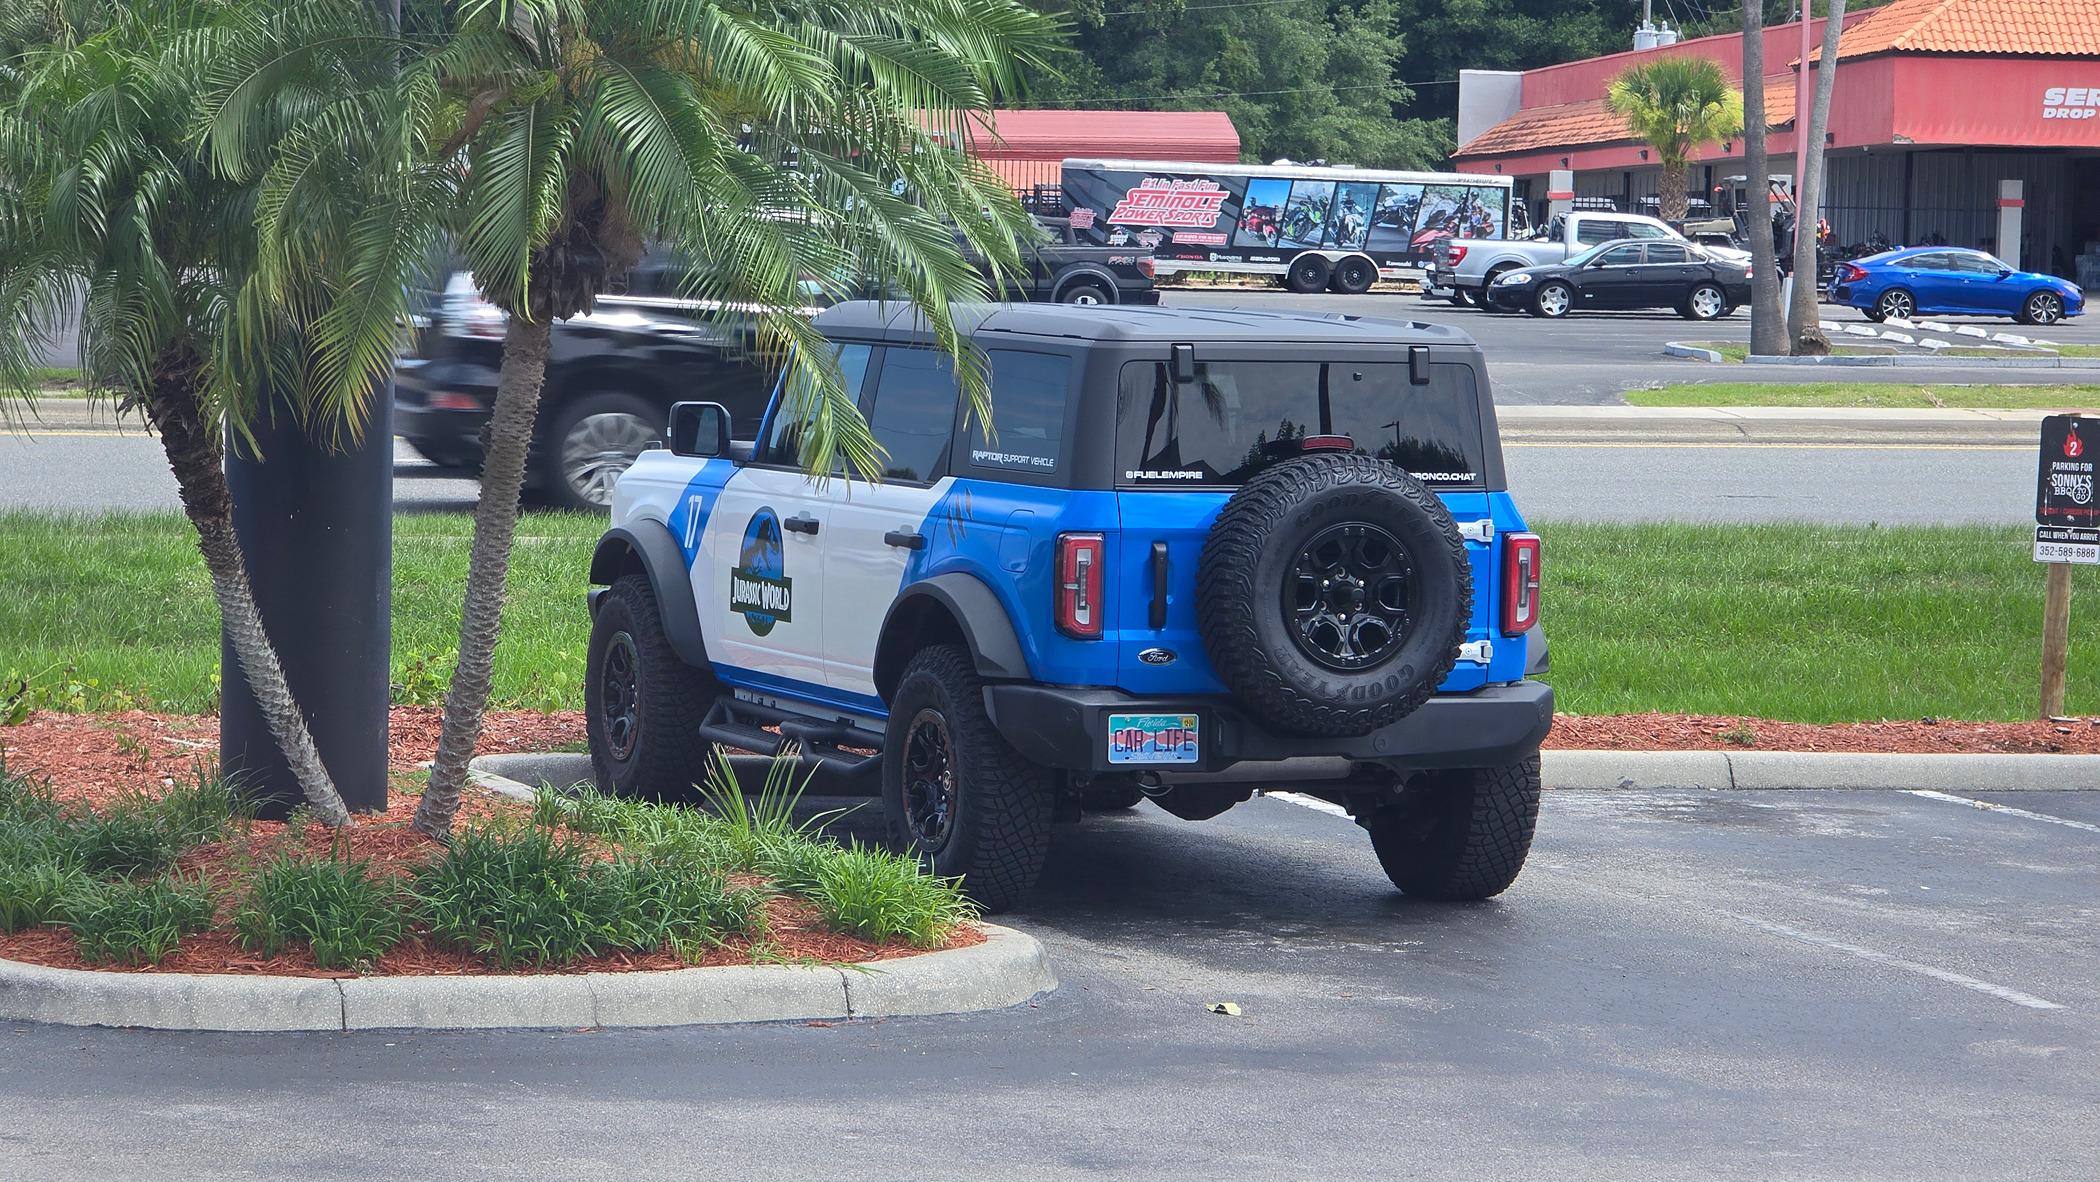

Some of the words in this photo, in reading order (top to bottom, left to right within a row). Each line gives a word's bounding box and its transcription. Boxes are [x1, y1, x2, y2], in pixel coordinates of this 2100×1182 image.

[2043, 108, 2097, 119] DROP
[1141, 177, 1157, 189] #1
[1158, 179, 1170, 189] In
[1171, 179, 1197, 191] Fast
[1197, 180, 1219, 191] Fun
[1116, 188, 1230, 210] SEMINOLE
[2069, 441, 2078, 456] 2
[972, 450, 1003, 464] RAPTOR
[1003, 453, 1030, 464] SUPPORT
[1030, 456, 1054, 467] VEHICLE
[2052, 462, 2080, 472] PARKING
[2080, 463, 2093, 472] FOR
[1125, 471, 1203, 479] @FUELEMPIRE
[2051, 474, 2092, 488] SONNY'S
[2054, 487, 2073, 497] BBQ
[684, 495, 703, 549] 17
[2039, 531, 2052, 539] CALL
[2053, 531, 2069, 540] WHEN
[2070, 532, 2080, 540] YOU
[2080, 533, 2099, 541] ARRIVE
[732, 576, 761, 606] JURASSIC
[761, 580, 790, 611] WORLD
[1147, 651, 1169, 662] Ford
[1137, 717, 1167, 728] Florida
[1114, 729, 1144, 753] CAR
[1153, 728, 1194, 752] LIFE
